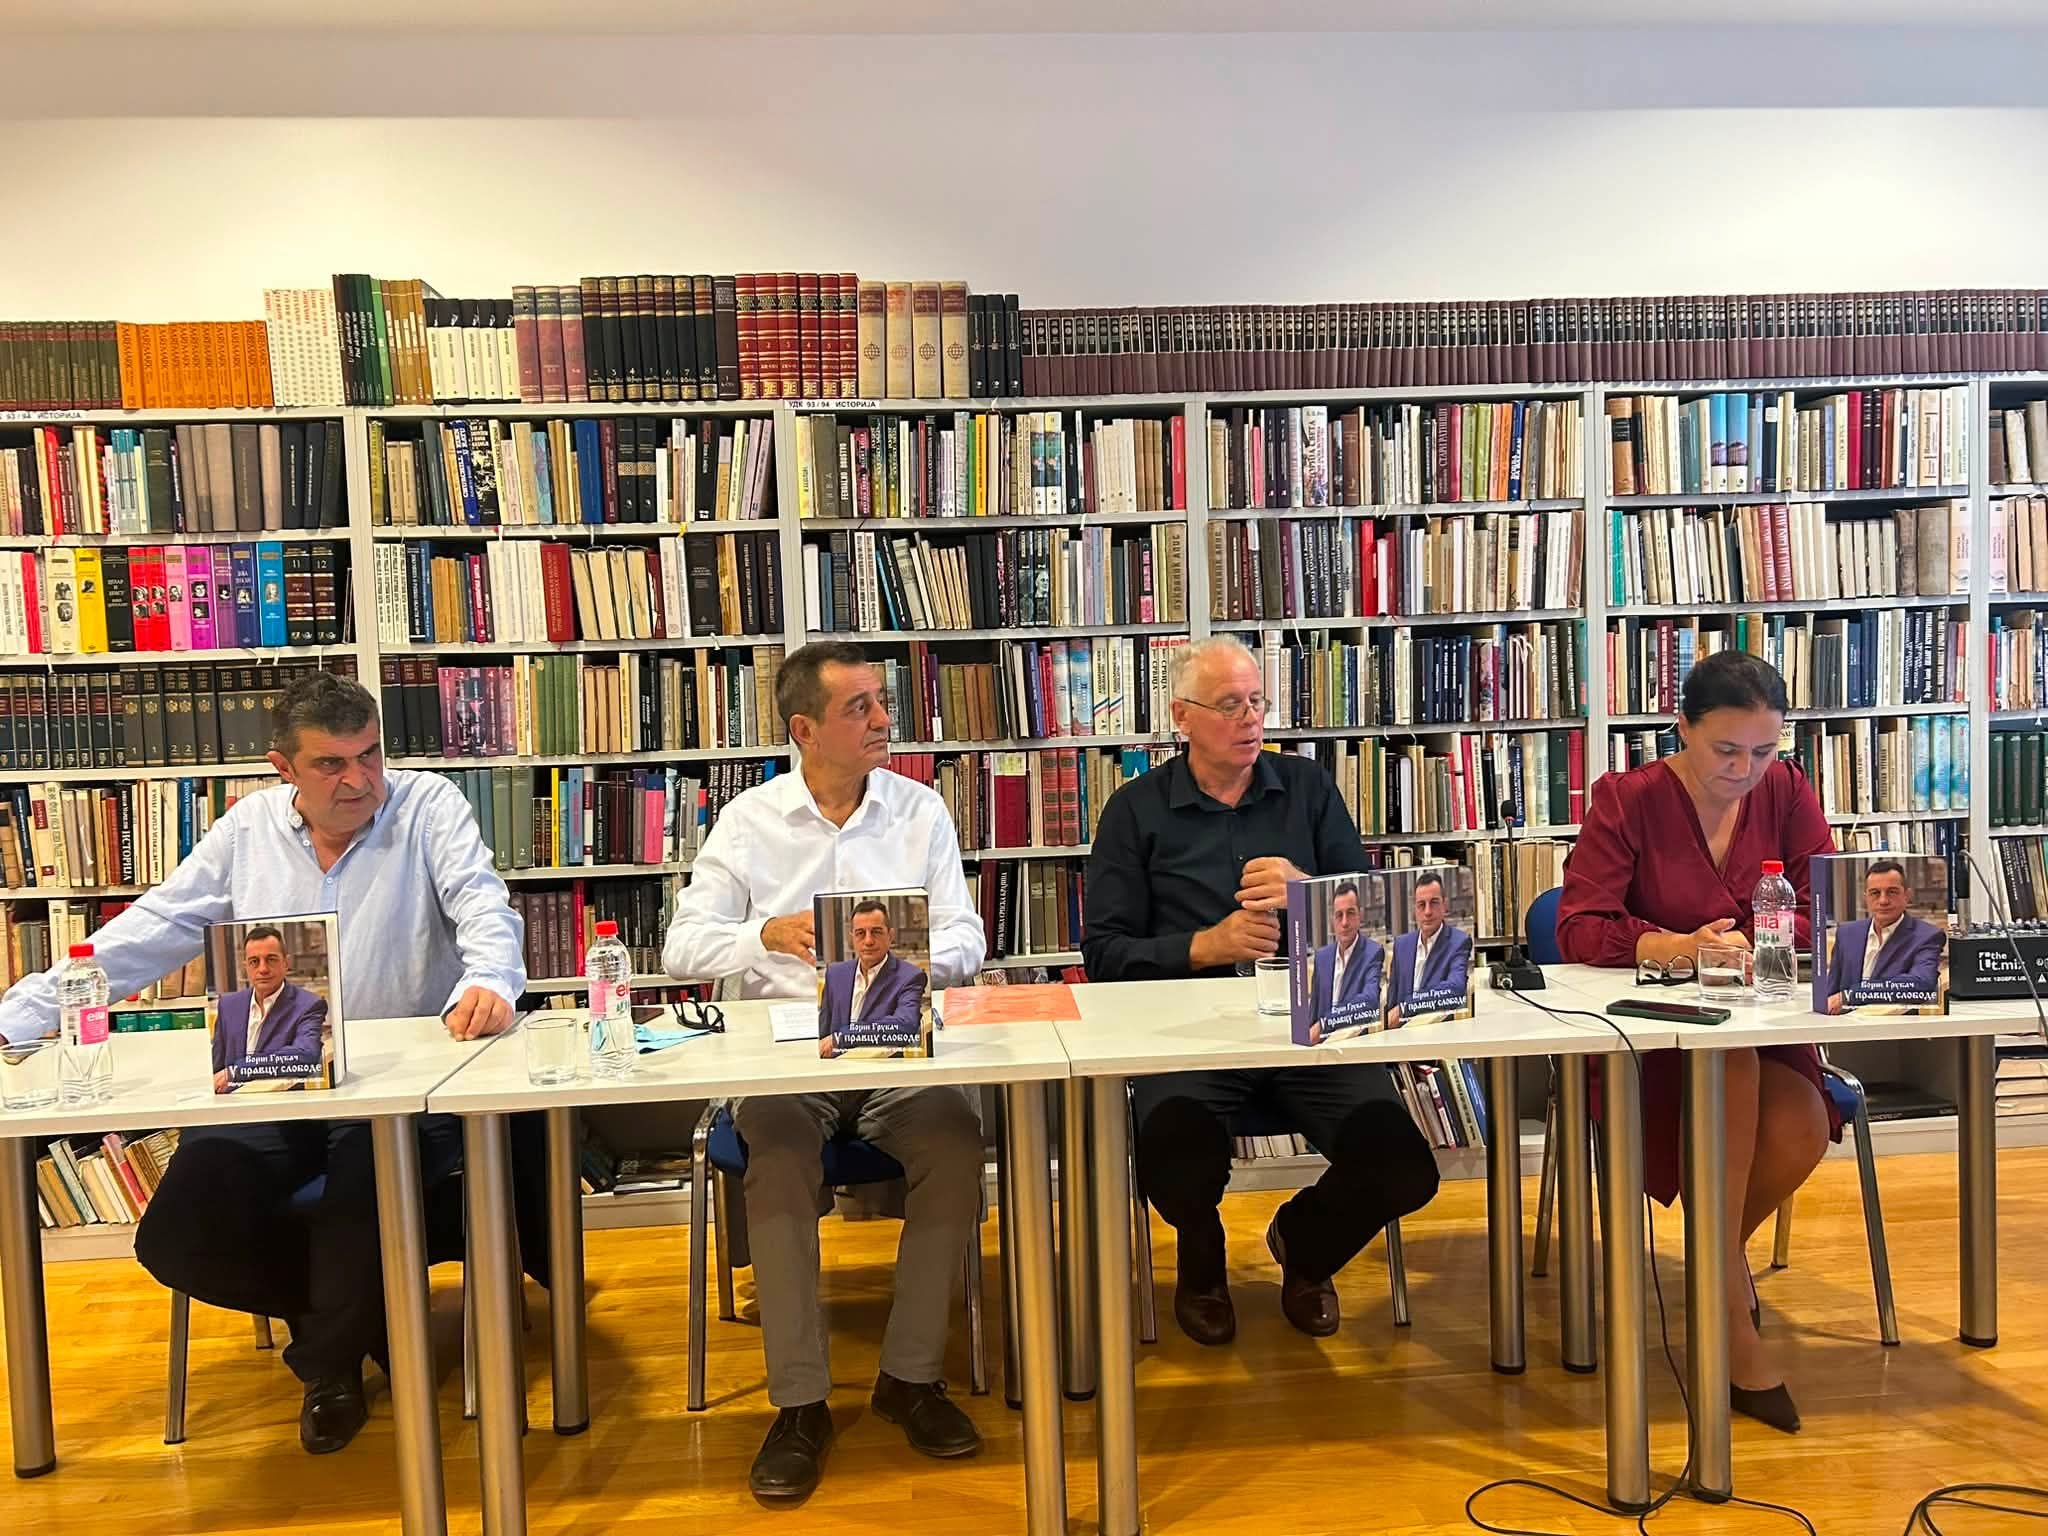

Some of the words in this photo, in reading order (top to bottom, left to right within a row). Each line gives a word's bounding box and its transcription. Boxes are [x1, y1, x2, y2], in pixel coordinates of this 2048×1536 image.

[788, 400, 803, 408] УДК
[835, 400, 876, 408] ИСТОРИЈА
[292, 559, 301, 569] 11
[317, 559, 327, 569] 12
[1754, 916, 1778, 928] ella
[1990, 952, 2008, 960] the
[1843, 990, 1853, 1001] У
[1855, 990, 1894, 1001] правцу
[1896, 991, 1937, 1000] слободе
[1400, 1002, 1406, 1014] У
[1408, 1000, 1437, 1011] правцу
[1438, 996, 1466, 1006] слободе
[1320, 1017, 1326, 1030] У
[1327, 1015, 1353, 1028] правцу
[1353, 1008, 1380, 1020] слободе
[833, 1032, 842, 1044] У
[844, 1034, 880, 1044] правцу
[882, 1033, 920, 1042] слободе
[228, 1066, 238, 1078] У
[240, 1065, 278, 1076] правцу
[280, 1064, 322, 1073] слободе
